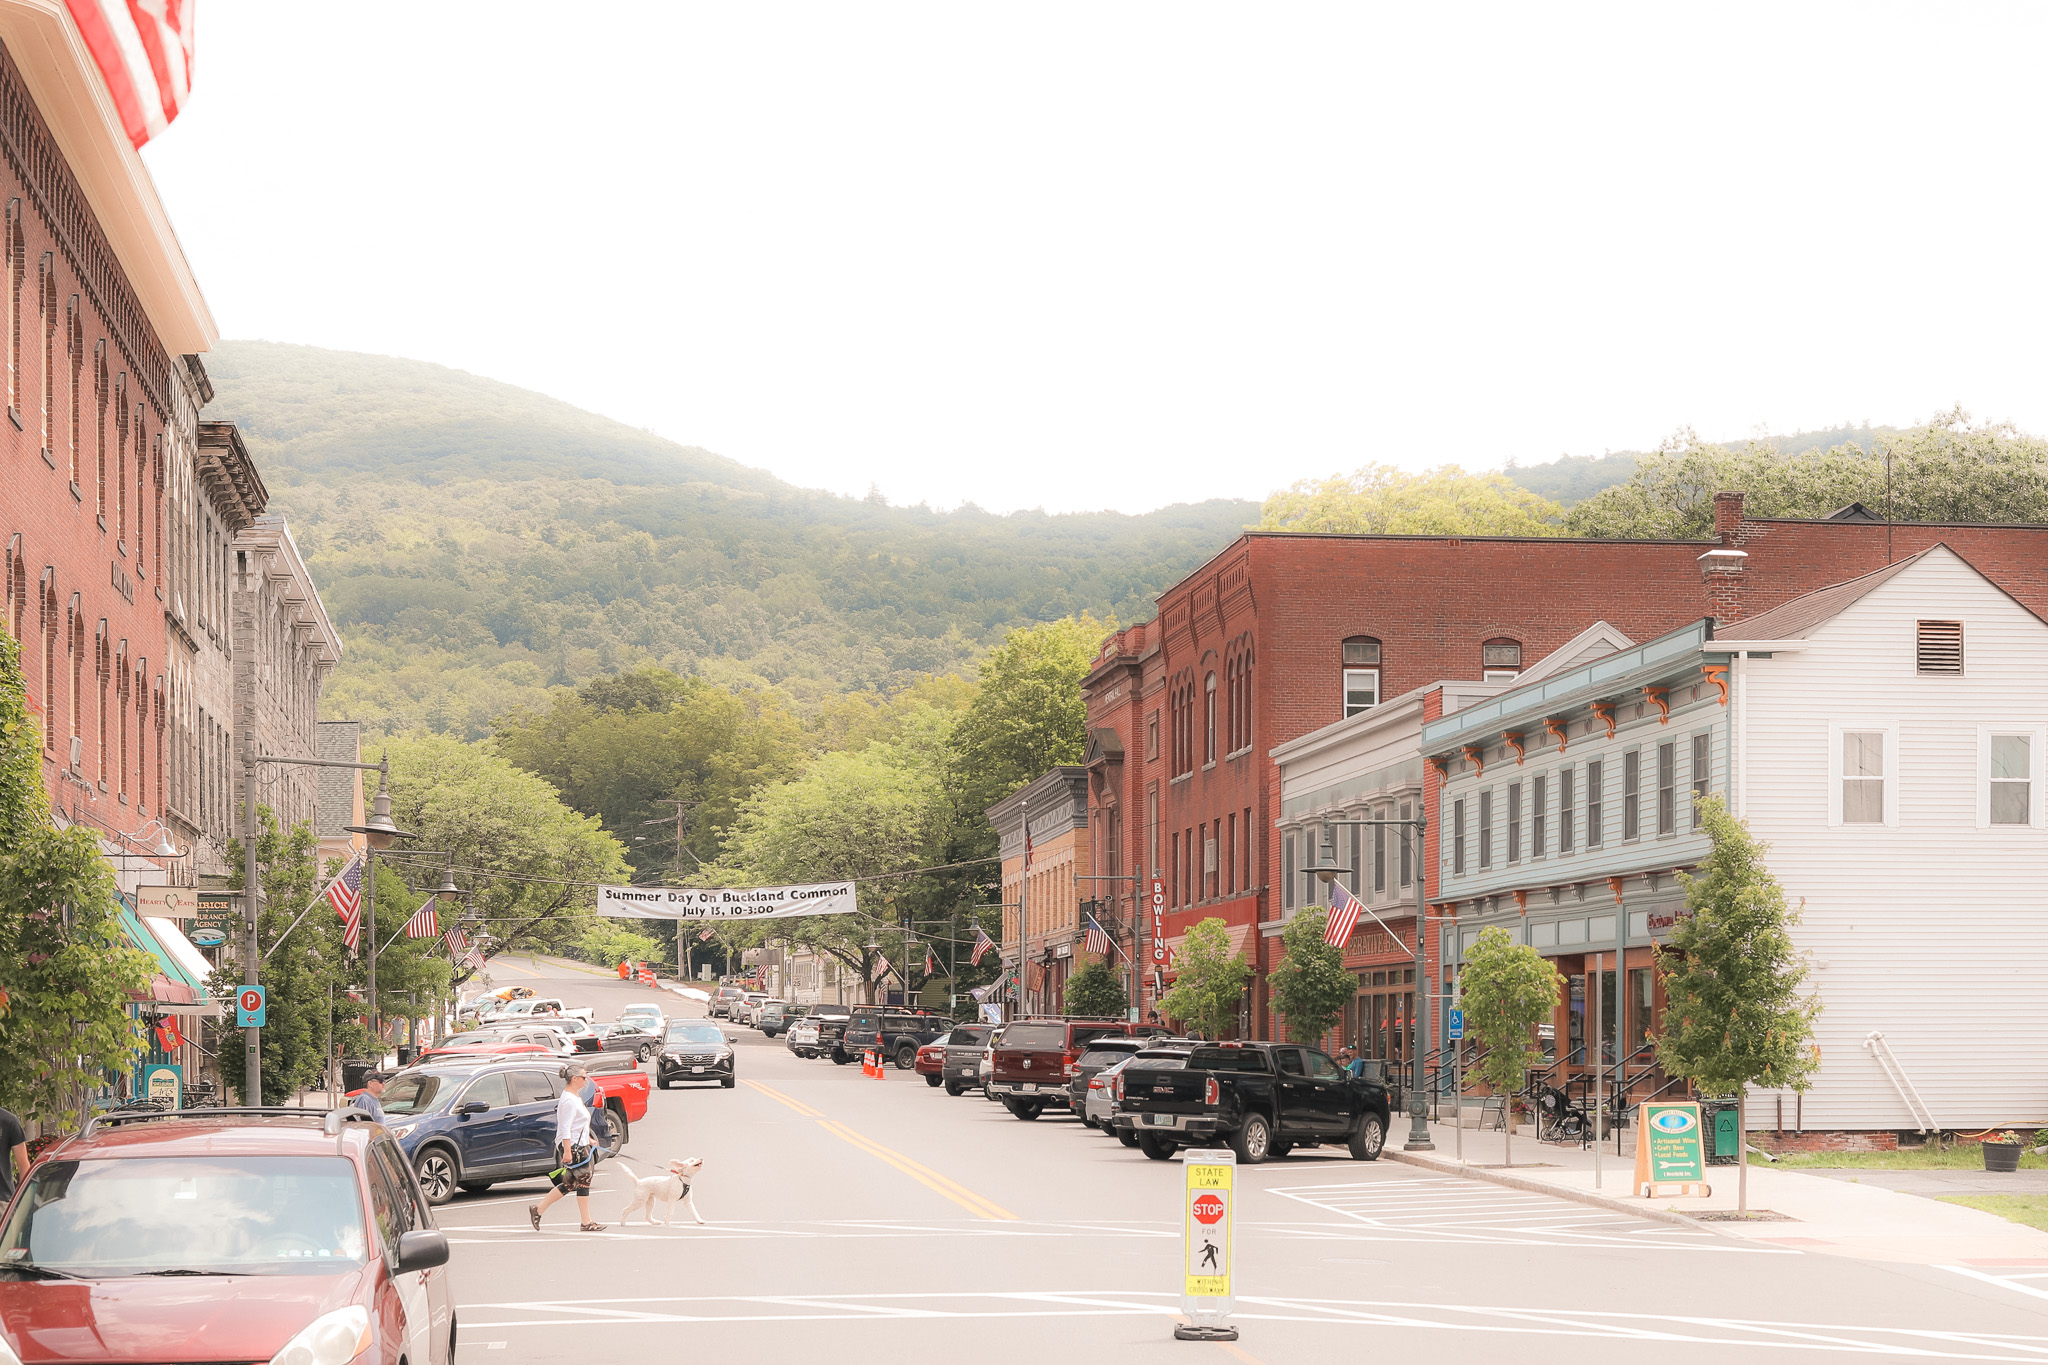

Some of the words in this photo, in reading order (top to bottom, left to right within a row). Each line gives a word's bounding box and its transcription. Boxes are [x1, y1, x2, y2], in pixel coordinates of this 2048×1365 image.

[605, 889, 661, 902] Summer
[668, 892, 694, 905] Day
[699, 893, 717, 902] On
[722, 891, 784, 902] Buckland
[790, 887, 848, 899] Common
[197, 901, 229, 909] IRICK
[682, 906, 706, 917] July
[730, 905, 774, 915] 10-3:00
[193, 920, 222, 928] AGENCY
[1153, 882, 1164, 960] BOWLING
[246, 994, 256, 1009] P
[1153, 1086, 1174, 1094] GMC
[1195, 1167, 1224, 1177] STATE
[1199, 1178, 1220, 1187] LAW
[1193, 1203, 1224, 1216] STOP
[1201, 1228, 1217, 1236] FOR
